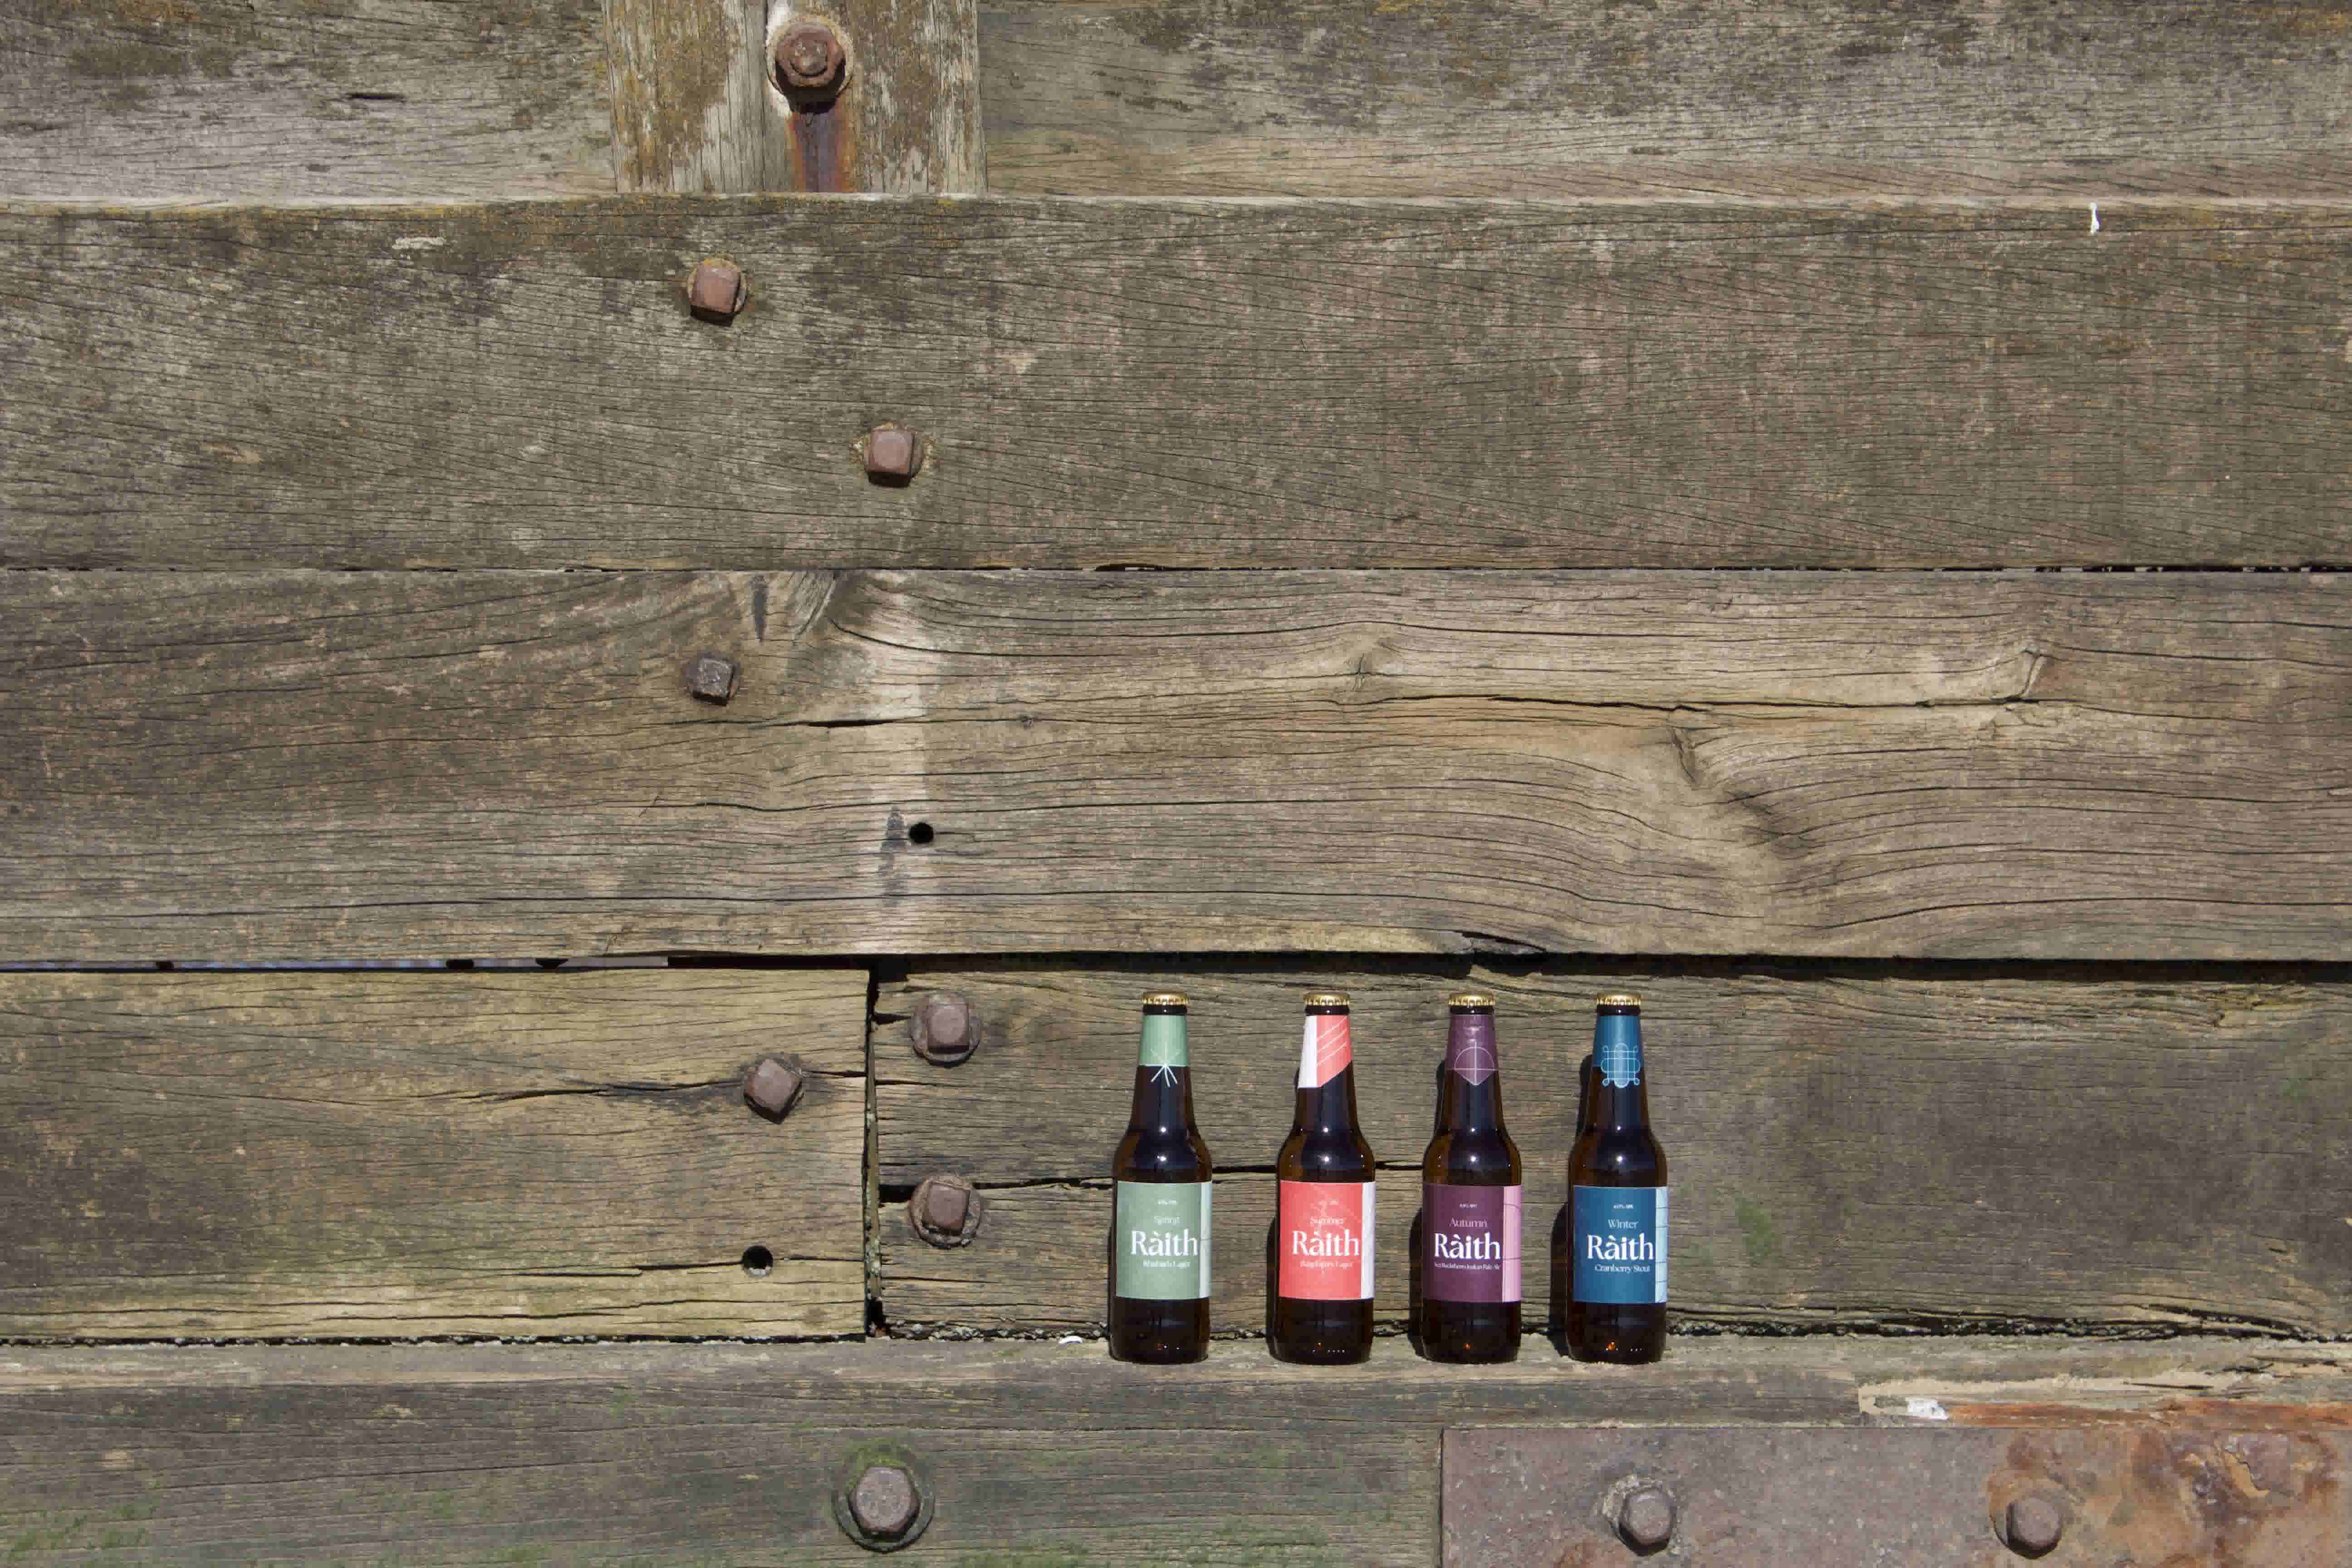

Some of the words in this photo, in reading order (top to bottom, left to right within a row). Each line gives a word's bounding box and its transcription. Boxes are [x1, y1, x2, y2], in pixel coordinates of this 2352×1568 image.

[1449, 1218, 1488, 1227] Autumn
[1607, 1219, 1639, 1229] Winter
[1131, 1228, 1198, 1256] Ràith
[1292, 1228, 1359, 1256] Ràith
[1434, 1232, 1501, 1259] Ràith
[1587, 1233, 1654, 1260] Ràith
[1594, 1264, 1631, 1274] Cranberry
[1633, 1264, 1651, 1272] Stout
